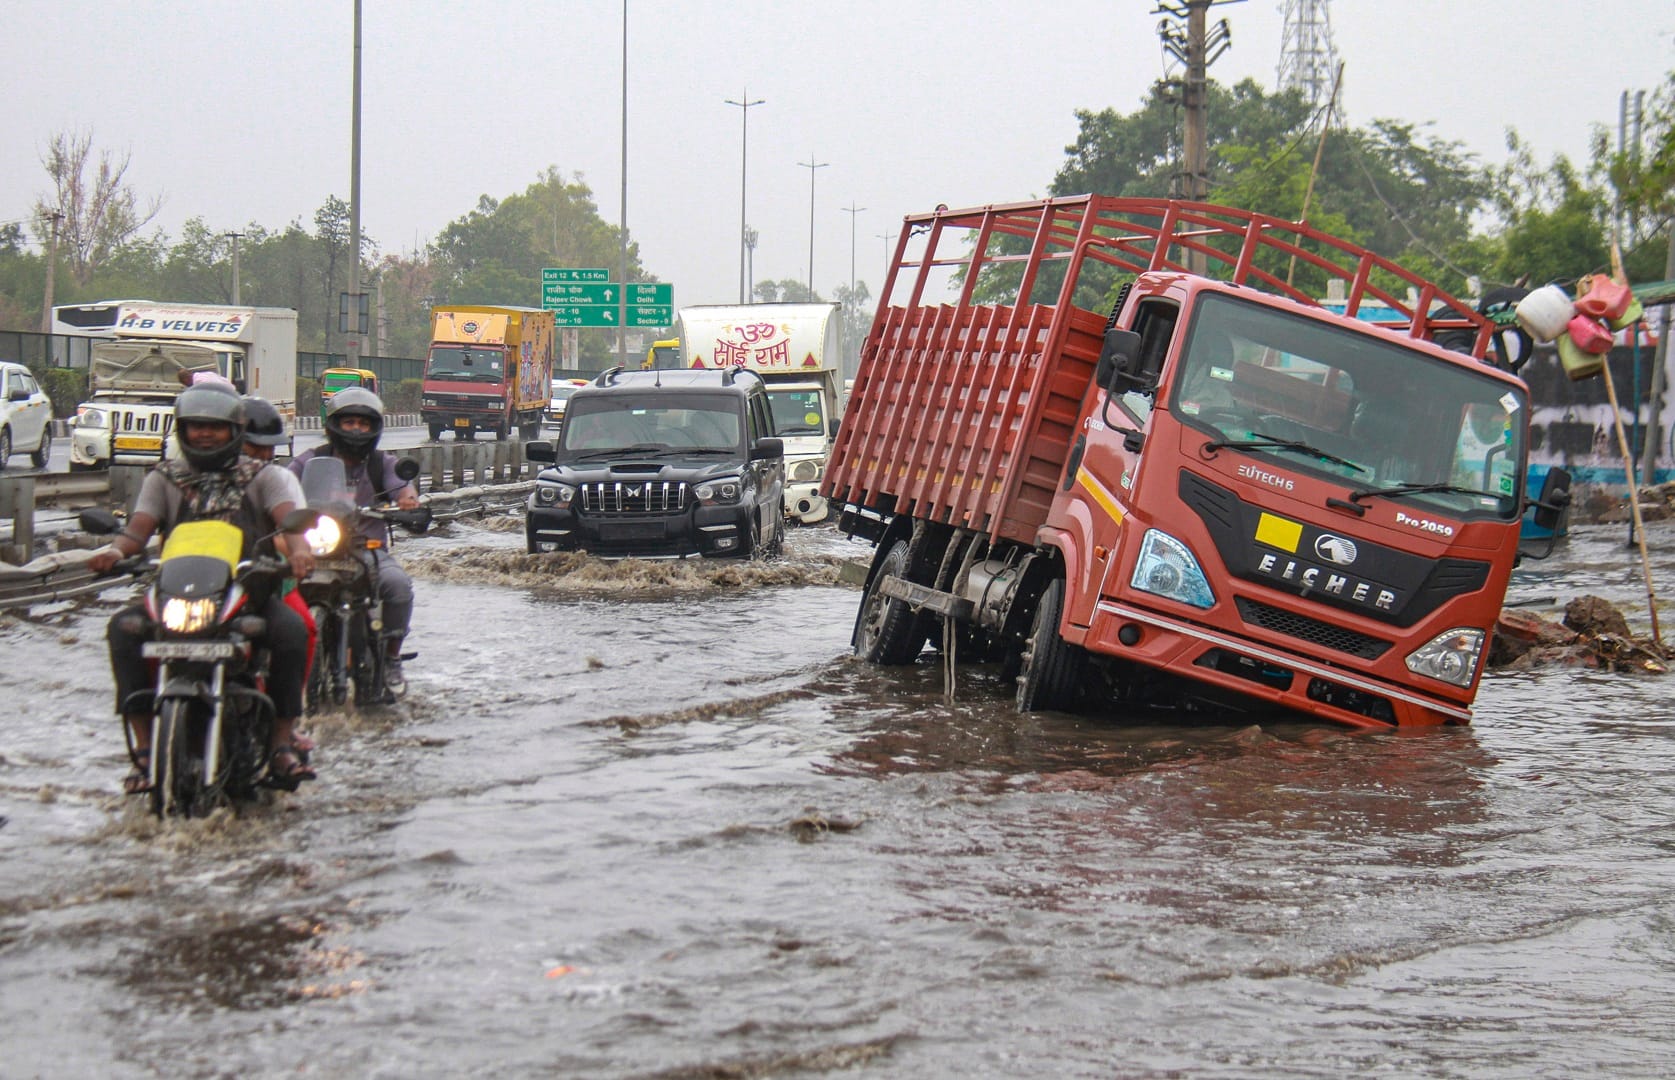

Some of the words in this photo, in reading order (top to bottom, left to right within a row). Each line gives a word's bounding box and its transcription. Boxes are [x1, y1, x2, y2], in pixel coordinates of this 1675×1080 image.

[546, 285, 566, 294] राजीव
[637, 285, 657, 294] दिल्ली
[545, 296, 568, 304] Rajeev
[161, 319, 242, 333] VELVETS
[754, 338, 790, 366] राम
[1395, 512, 1419, 528] Pro
[1420, 519, 1453, 537] 2059
[1257, 553, 1396, 611] EICHER
